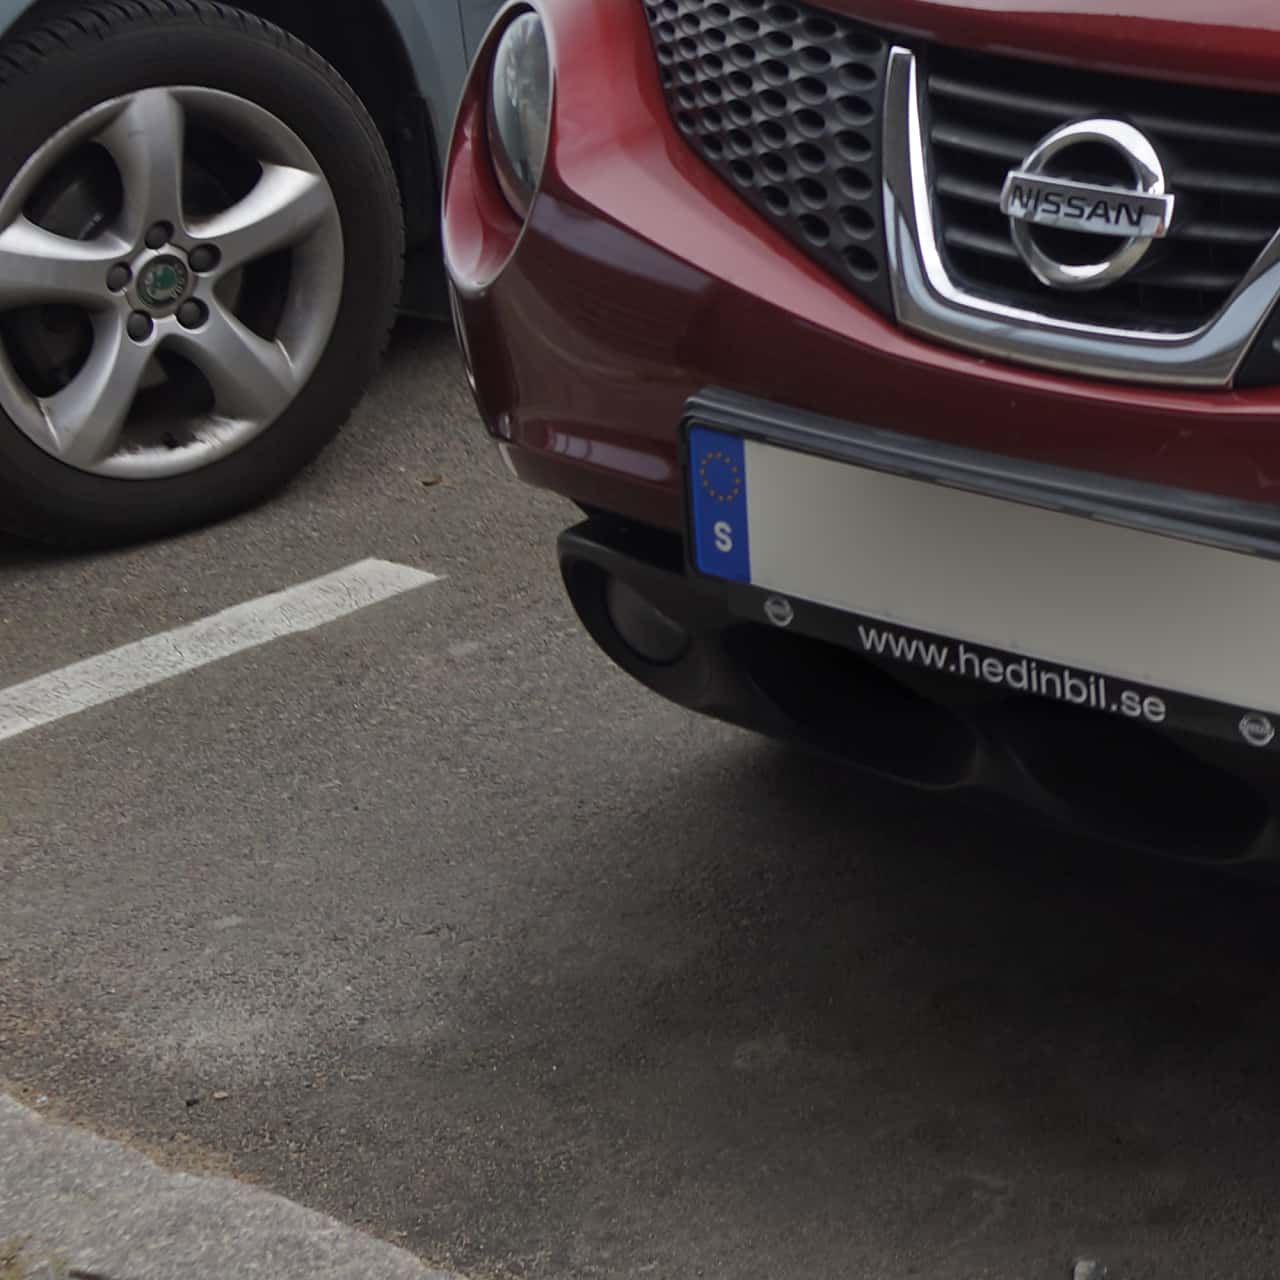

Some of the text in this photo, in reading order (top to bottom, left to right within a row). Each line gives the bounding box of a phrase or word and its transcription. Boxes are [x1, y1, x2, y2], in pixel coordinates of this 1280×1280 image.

[1010, 184, 1146, 228] NISSAN
[713, 521, 733, 553] S
[857, 624, 1167, 723] www.hedinbil.se
